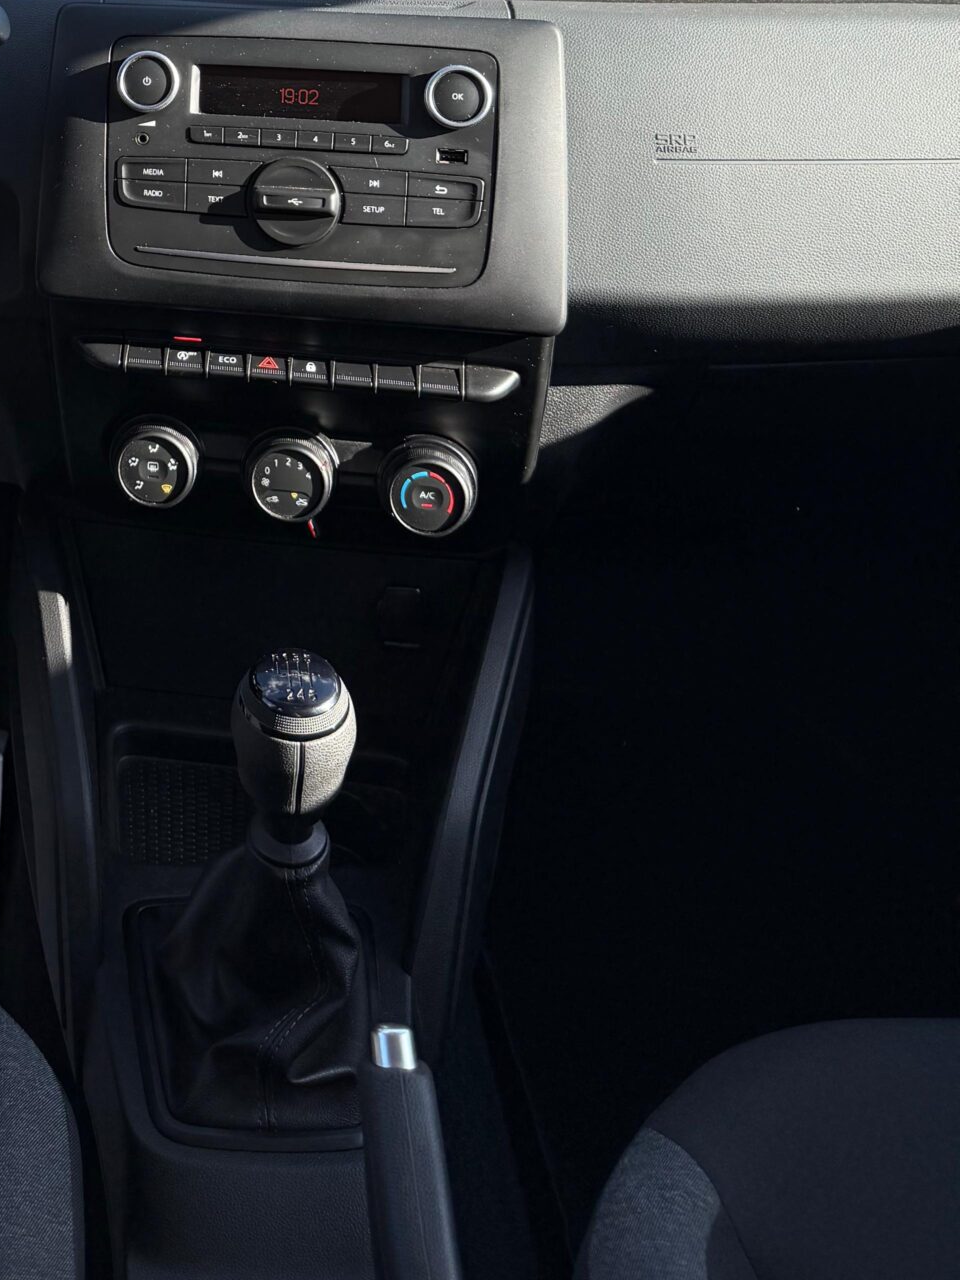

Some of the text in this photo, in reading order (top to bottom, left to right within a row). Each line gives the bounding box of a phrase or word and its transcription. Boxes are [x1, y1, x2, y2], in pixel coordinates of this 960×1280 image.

[279, 88, 320, 105] 19:02
[451, 92, 464, 101] OK
[655, 133, 696, 145] SRP
[655, 145, 698, 154] AIRBAG
[142, 168, 164, 176] MEDIA
[143, 189, 163, 197] RADIO
[362, 205, 385, 214] SETUP
[432, 207, 445, 216] TEL
[218, 355, 237, 364] ECO
[264, 466, 271, 475] 0
[419, 491, 436, 500] A/C
